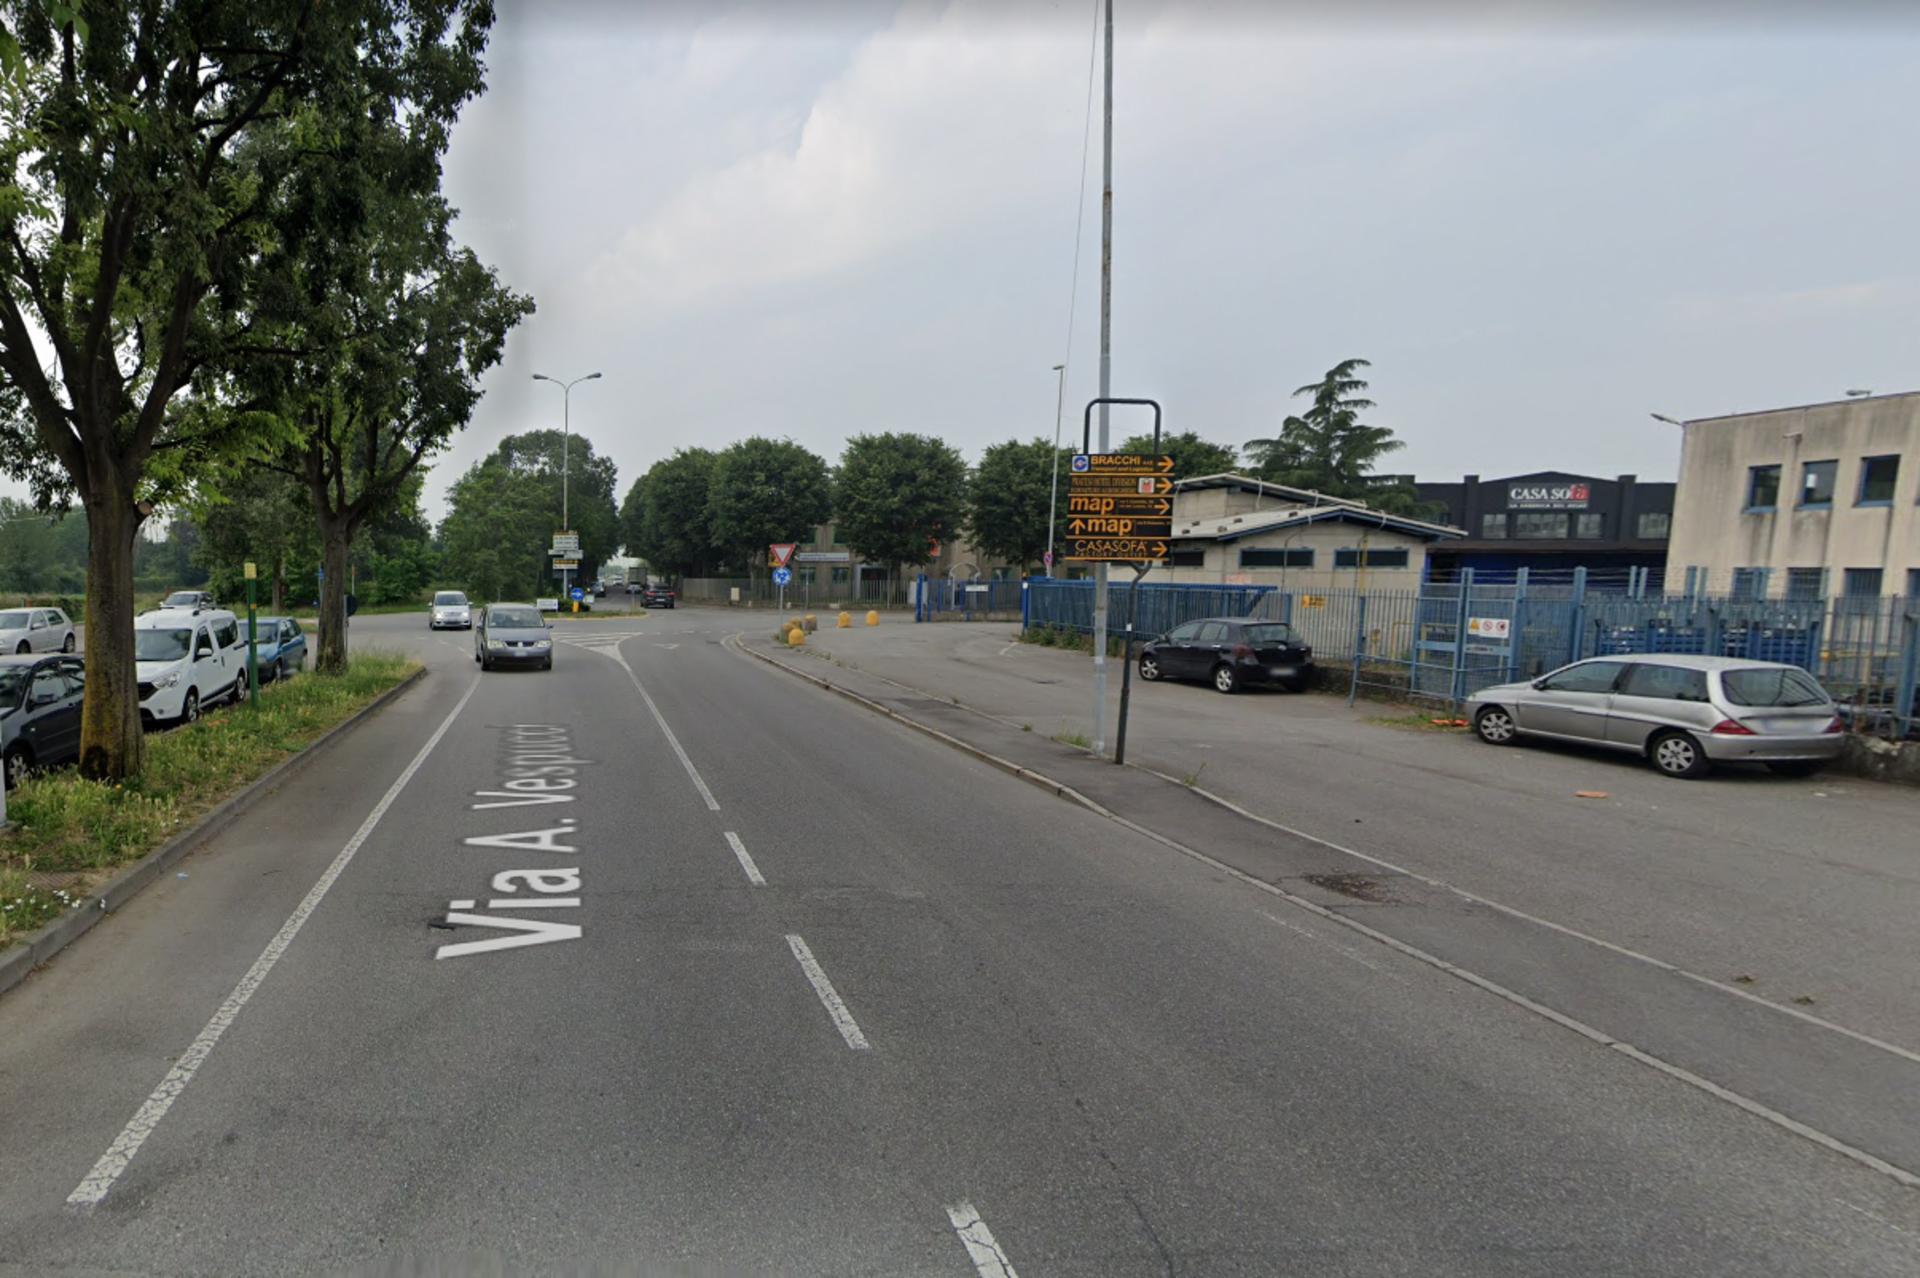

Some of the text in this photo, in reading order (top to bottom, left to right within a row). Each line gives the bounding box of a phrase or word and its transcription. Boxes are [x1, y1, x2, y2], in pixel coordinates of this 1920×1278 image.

[1091, 456, 1141, 465] BRACCHI
[1510, 487, 1548, 500] CASA
[1070, 498, 1114, 515] map
[1087, 519, 1132, 536] map
